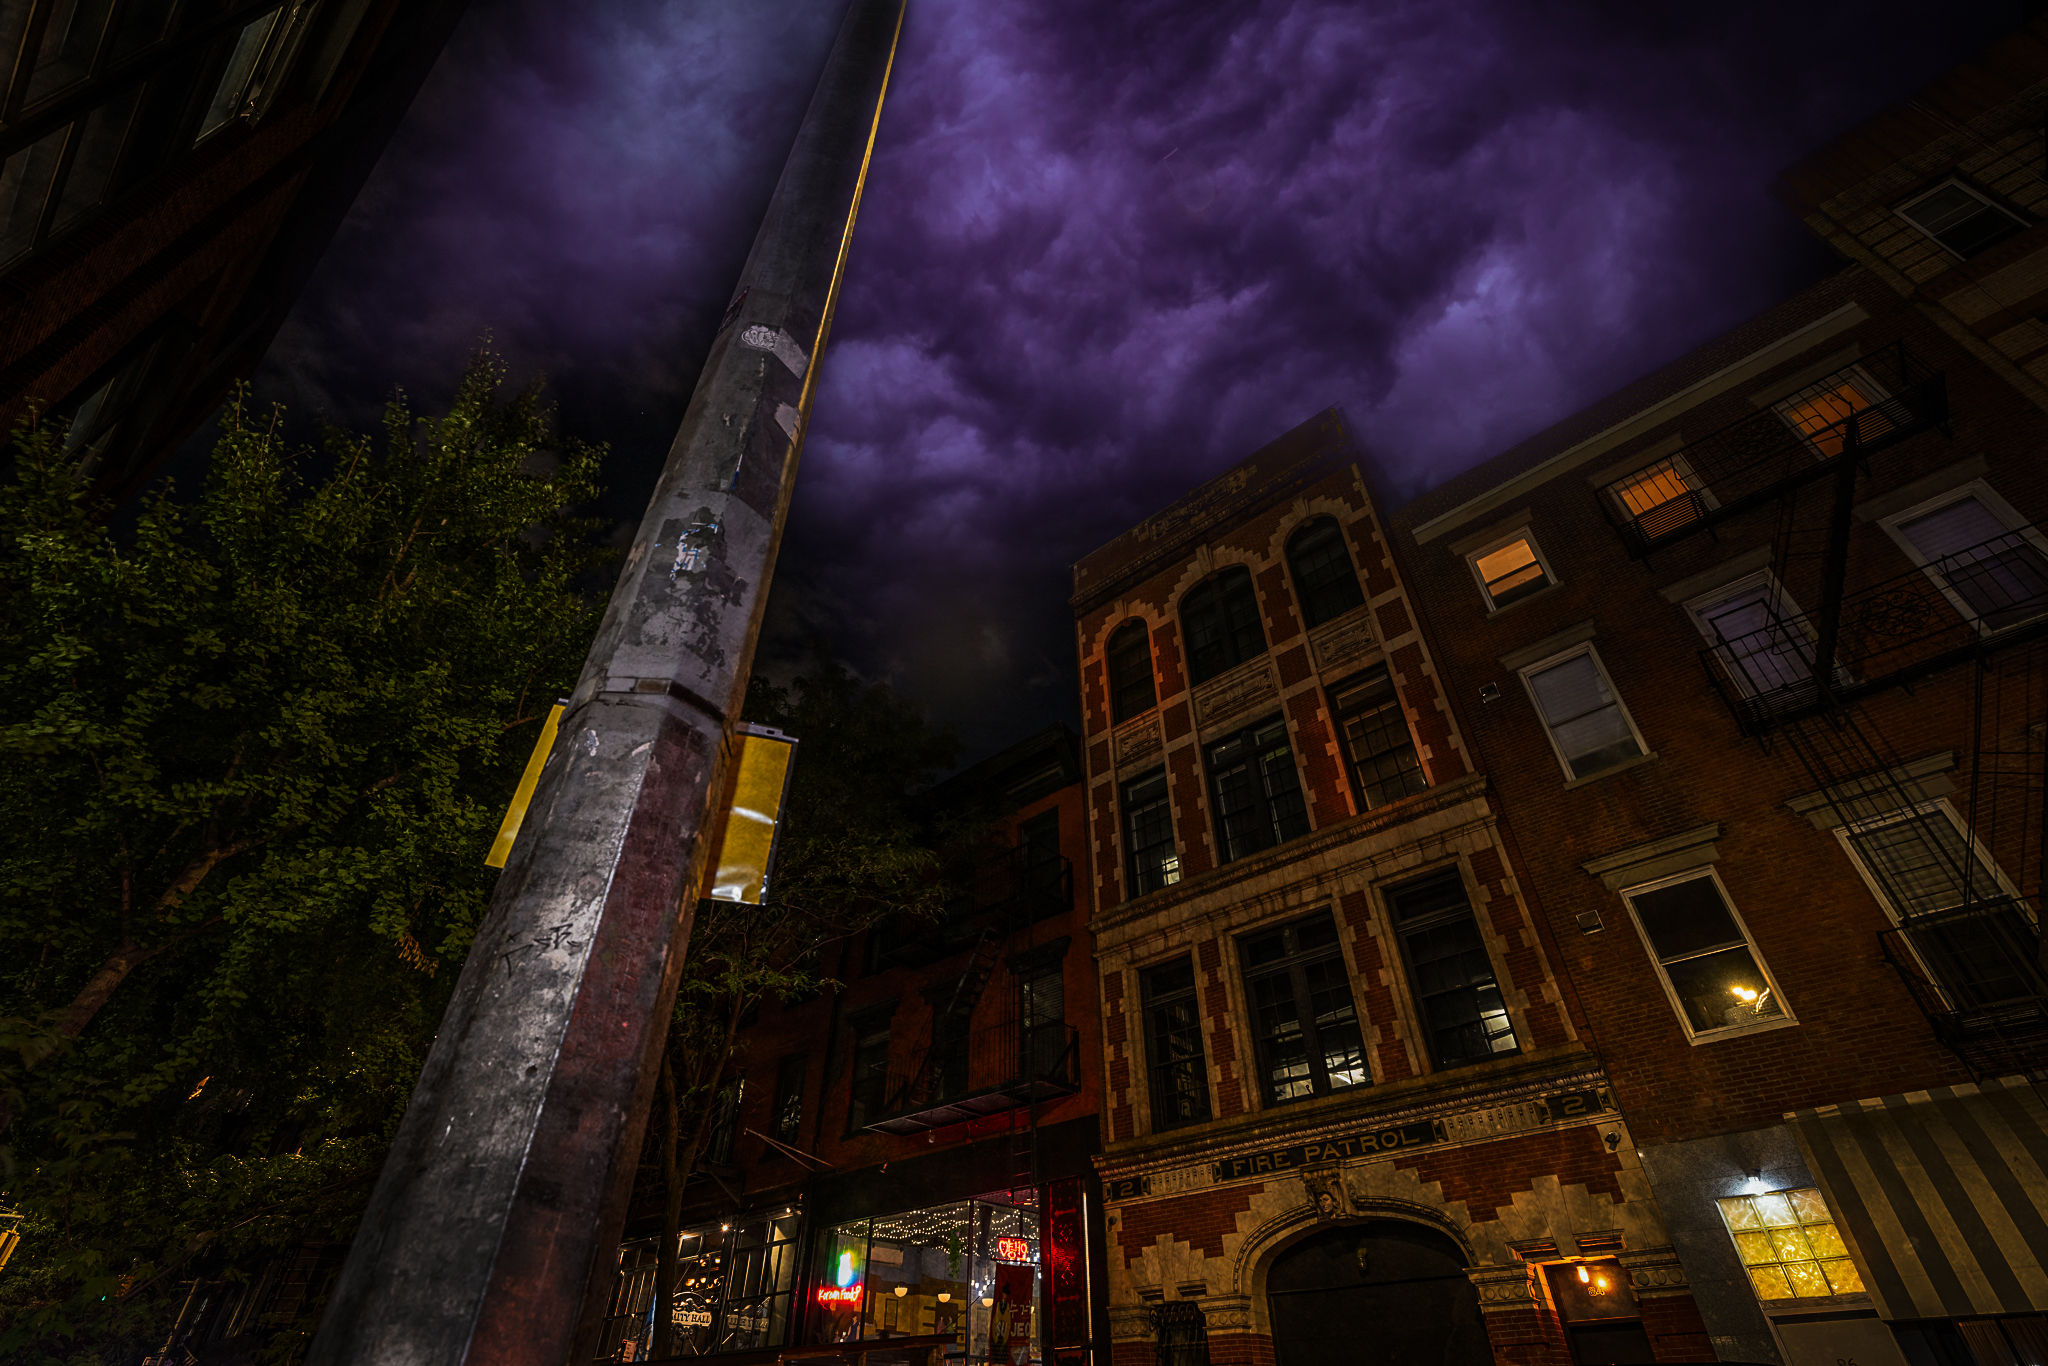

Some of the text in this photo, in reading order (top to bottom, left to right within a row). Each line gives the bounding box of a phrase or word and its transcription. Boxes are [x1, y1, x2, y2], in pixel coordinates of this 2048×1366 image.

[1563, 1095, 1586, 1115] 2
[1232, 1129, 1420, 1177] FIRE PATROL
[1119, 1179, 1136, 1196] 2
[818, 1289, 840, 1301] Korean
[673, 1312, 710, 1323] ITY HALL
